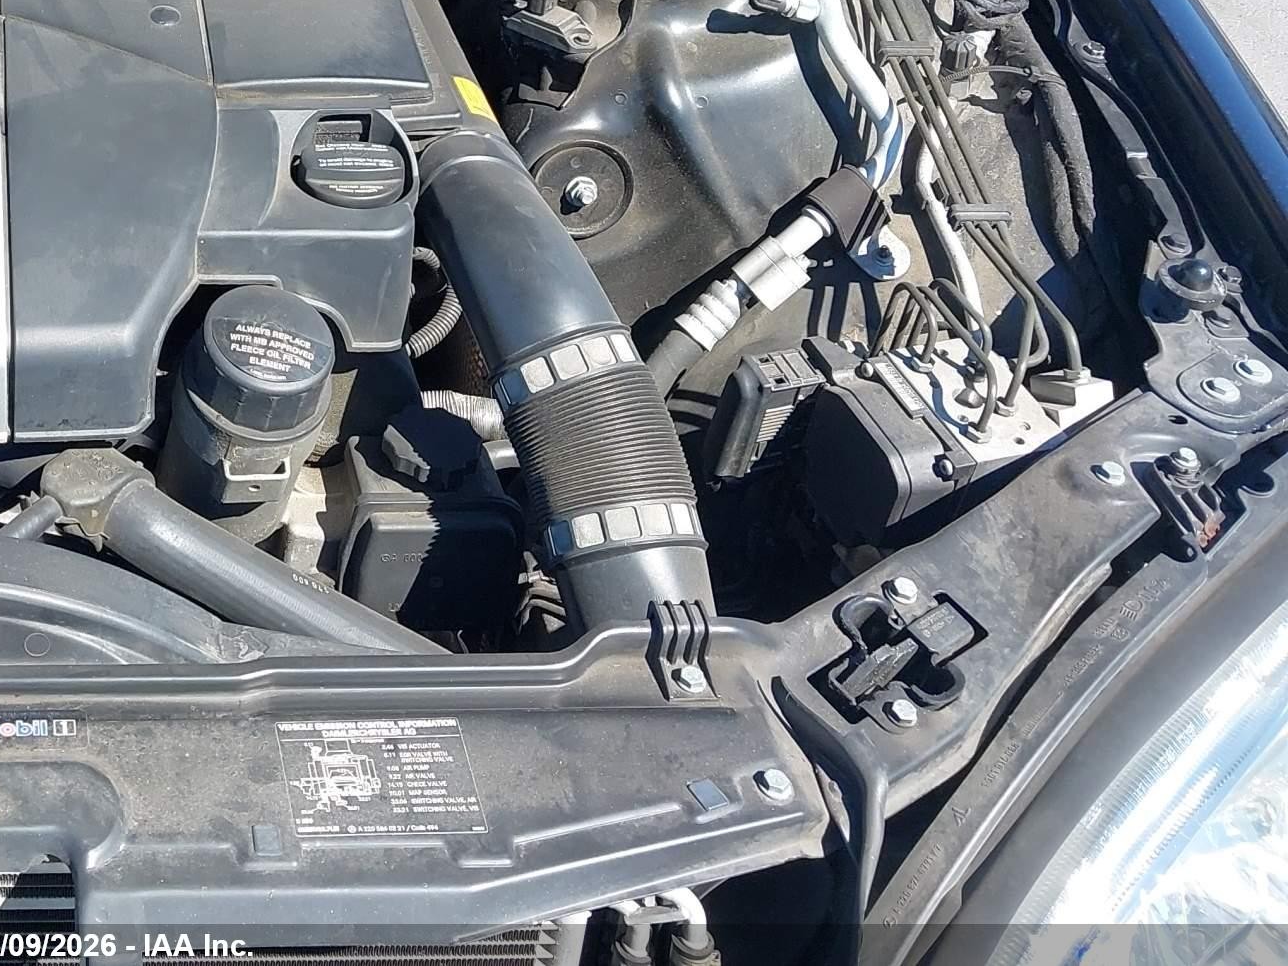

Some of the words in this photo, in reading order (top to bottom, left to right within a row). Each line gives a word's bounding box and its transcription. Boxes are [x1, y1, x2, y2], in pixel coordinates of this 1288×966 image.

[236, 324, 271, 337] ALWAYS
[272, 329, 311, 349] REPLACE
[230, 333, 252, 344] WITH
[254, 336, 268, 346] MB
[268, 339, 315, 361] APPROVED
[231, 343, 265, 355] FLEECE
[266, 349, 282, 360] OIL
[282, 352, 311, 370] FILTER
[249, 356, 291, 372] ELEMENT
[278, 723, 314, 731] VEHICLE
[314, 722, 356, 730] EMISSION
[357, 721, 398, 729] CONTROL
[398, 719, 457, 728] INFORMATION
[321, 729, 402, 738] DAIMLERCHRYSLER
[404, 728, 416, 736] AG
